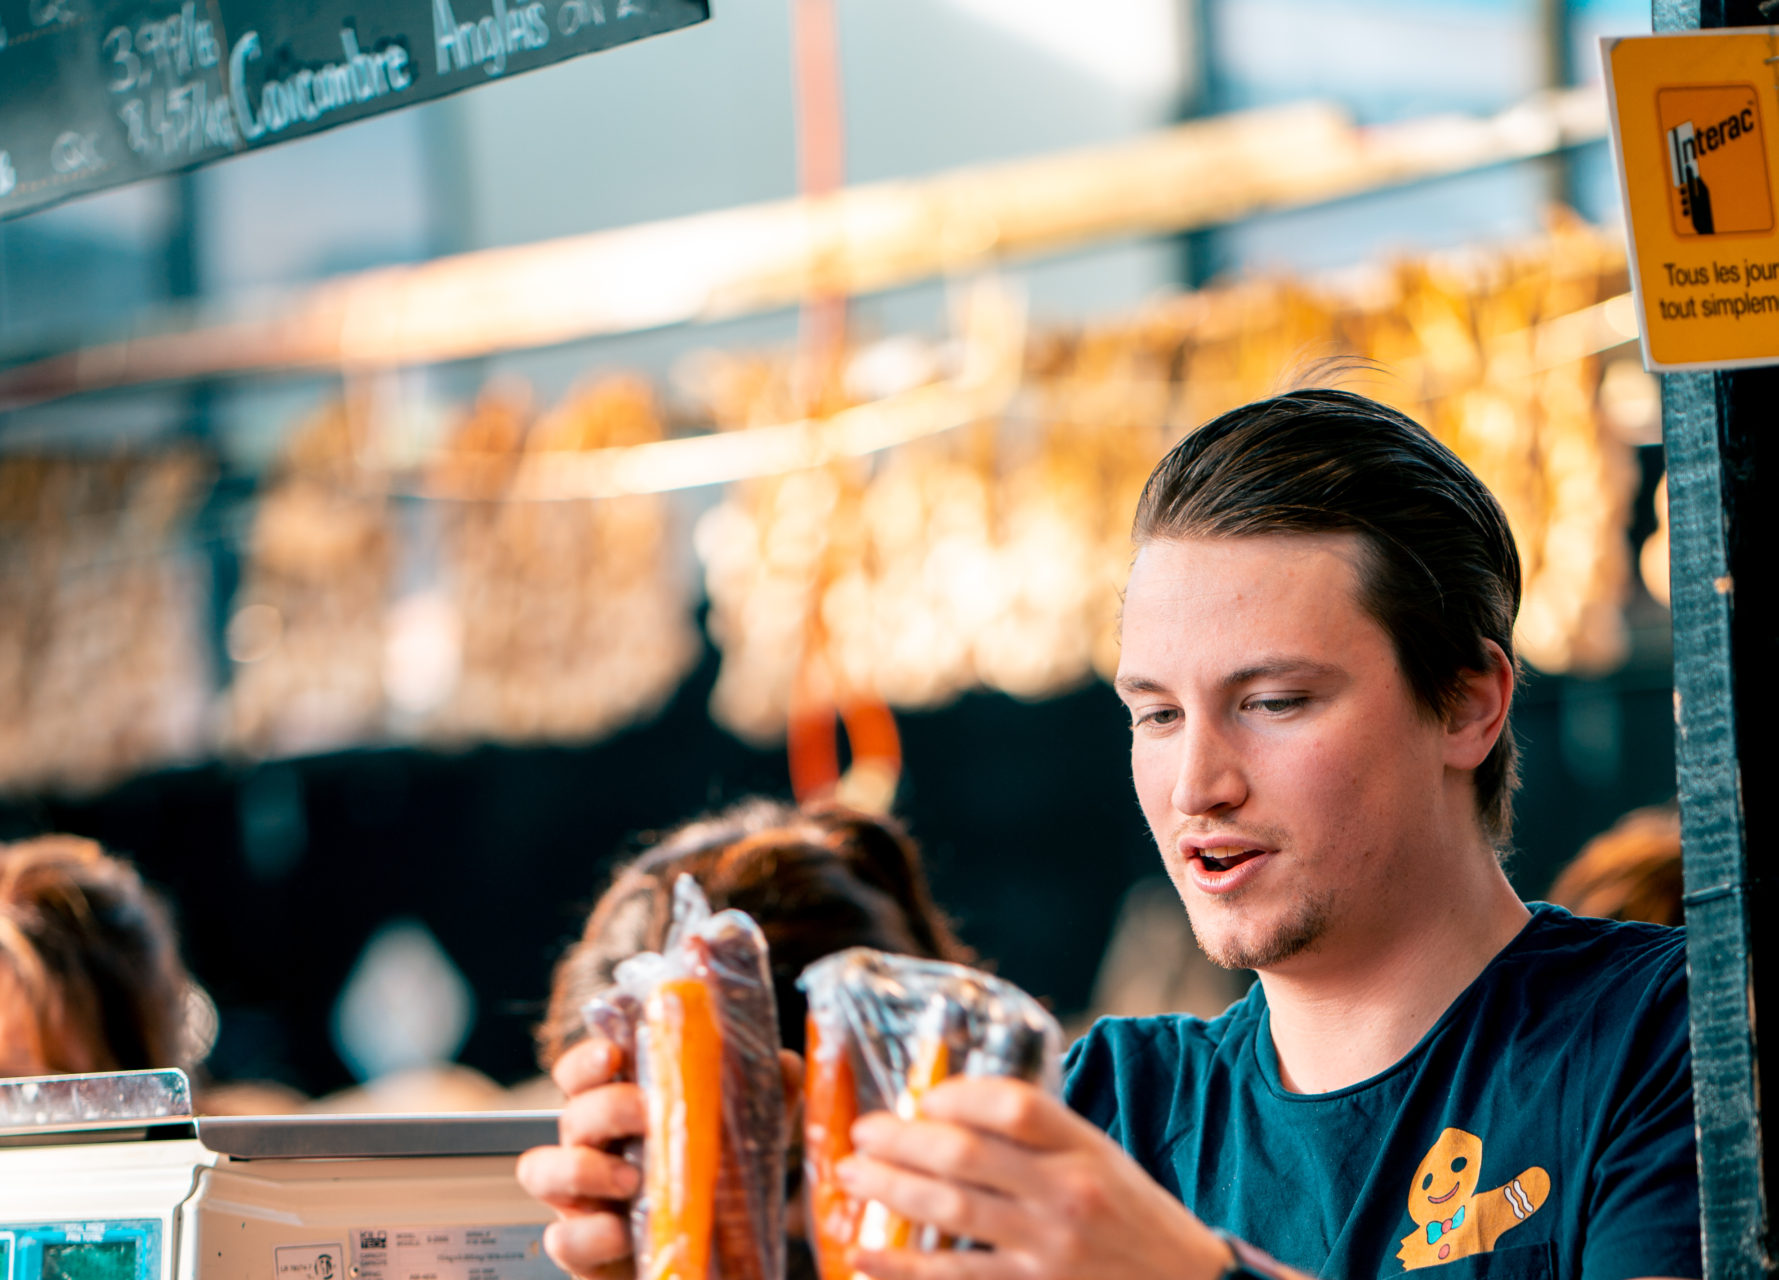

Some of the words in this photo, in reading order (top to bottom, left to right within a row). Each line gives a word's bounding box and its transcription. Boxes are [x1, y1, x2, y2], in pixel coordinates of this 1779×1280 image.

[1672, 106, 1754, 186] Interac
[1662, 261, 1709, 287] Tous
[1712, 260, 1741, 284] les
[1659, 297, 1696, 320] tout
